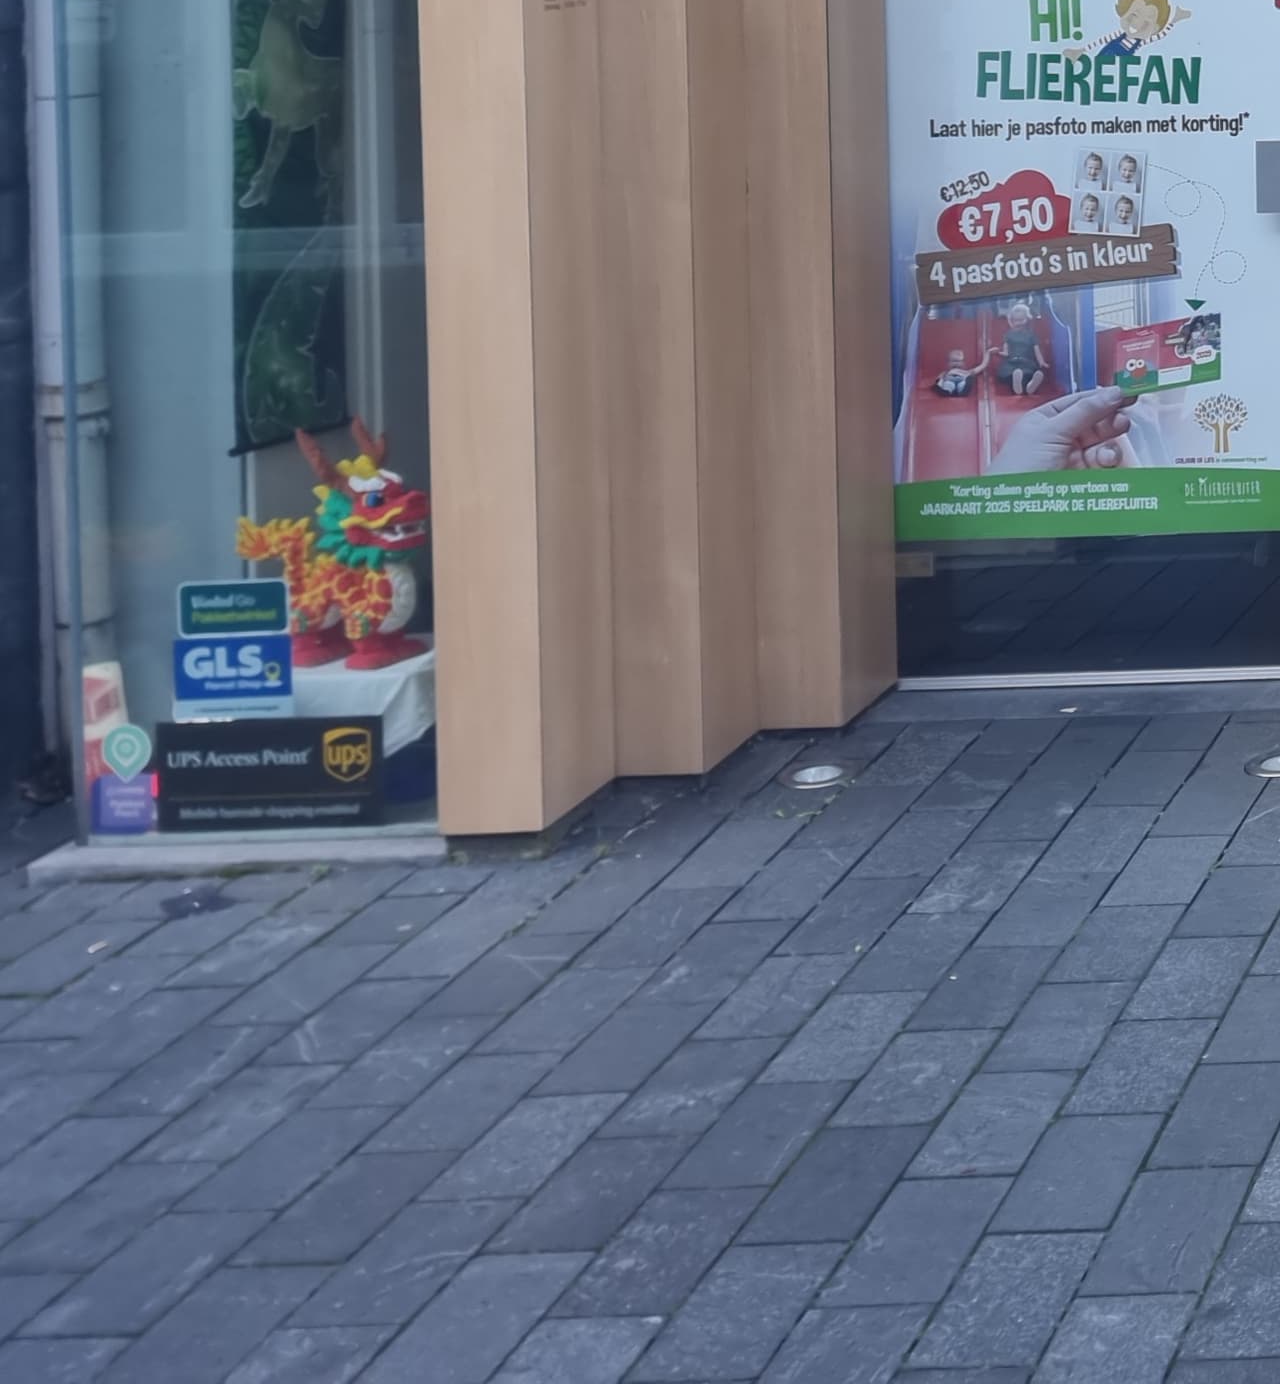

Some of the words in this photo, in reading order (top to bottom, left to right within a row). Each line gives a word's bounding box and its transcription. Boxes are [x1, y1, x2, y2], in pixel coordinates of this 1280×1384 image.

[976, 50, 1202, 106] FLIEREFAN
[930, 119, 967, 139] Laat
[971, 118, 1003, 138] hier
[1005, 118, 1022, 141] je
[1025, 117, 1087, 142] pasfoto
[1090, 117, 1142, 135] maken
[1146, 116, 1177, 134] met
[939, 171, 990, 203] €12,50
[958, 197, 1055, 243] €7,50
[929, 261, 946, 287] 4
[951, 245, 1062, 293] pasfoto's
[1067, 247, 1089, 271] in
[1092, 240, 1153, 269] kleur
[993, 484, 1022, 496] alleen
[1024, 483, 1053, 498] geldig
[1056, 484, 1069, 496] op
[1071, 482, 1109, 494] vertoon
[1111, 483, 1129, 492] van
[920, 502, 983, 516] JAARKAART
[985, 500, 1010, 513] 2025
[1012, 499, 1070, 513] SPEELPARK
[1071, 499, 1085, 512] DE
[183, 644, 263, 679] GLS
[167, 752, 200, 768] UPS
[204, 750, 260, 767] Access
[262, 748, 309, 765] Point
[328, 743, 367, 773] ups
